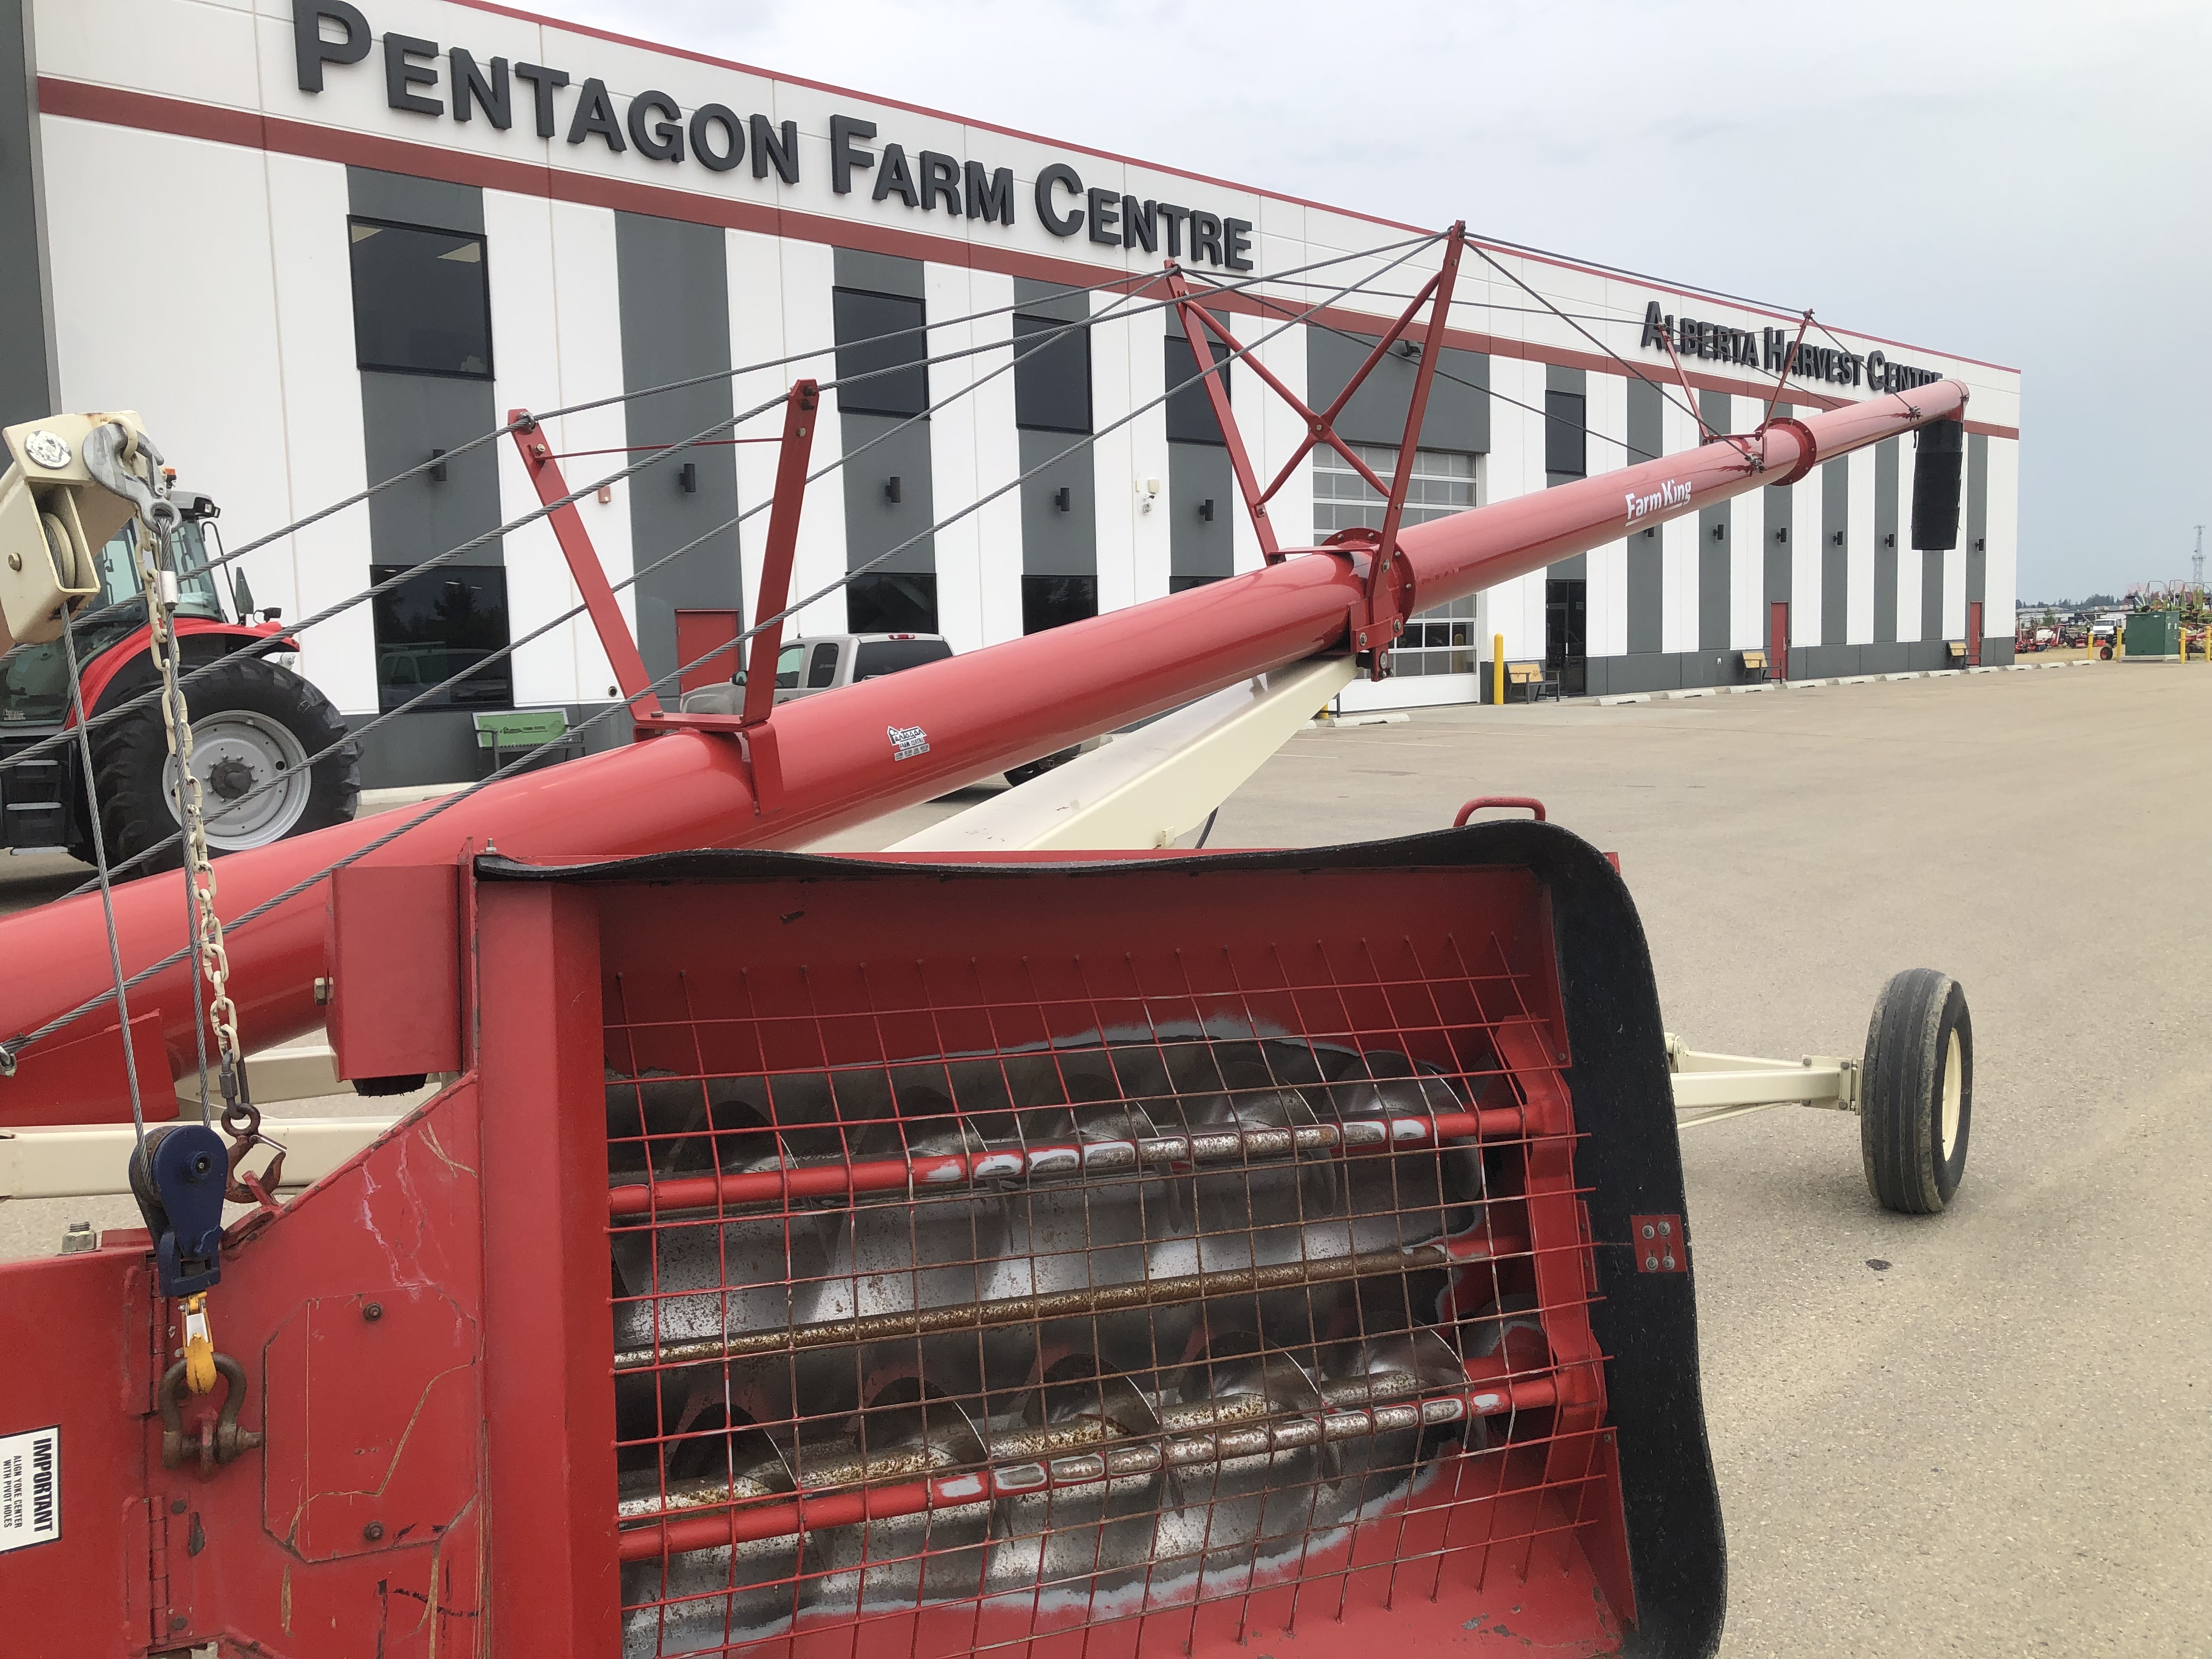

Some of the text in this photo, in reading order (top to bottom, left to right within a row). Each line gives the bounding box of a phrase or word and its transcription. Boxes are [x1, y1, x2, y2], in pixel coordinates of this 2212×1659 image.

[292, 0, 1254, 271] PENTAGON FARM CENTRE
[1640, 301, 1760, 368] ALBERTA
[1764, 326, 1864, 386] HARVEST
[1625, 479, 1692, 520] Farm King
[3, 1459, 12, 1528] WITH PIVOT HOLES
[13, 1455, 22, 1528] ALIGN YOKE CENTER
[33, 1437, 53, 1532] IMPORTANT
